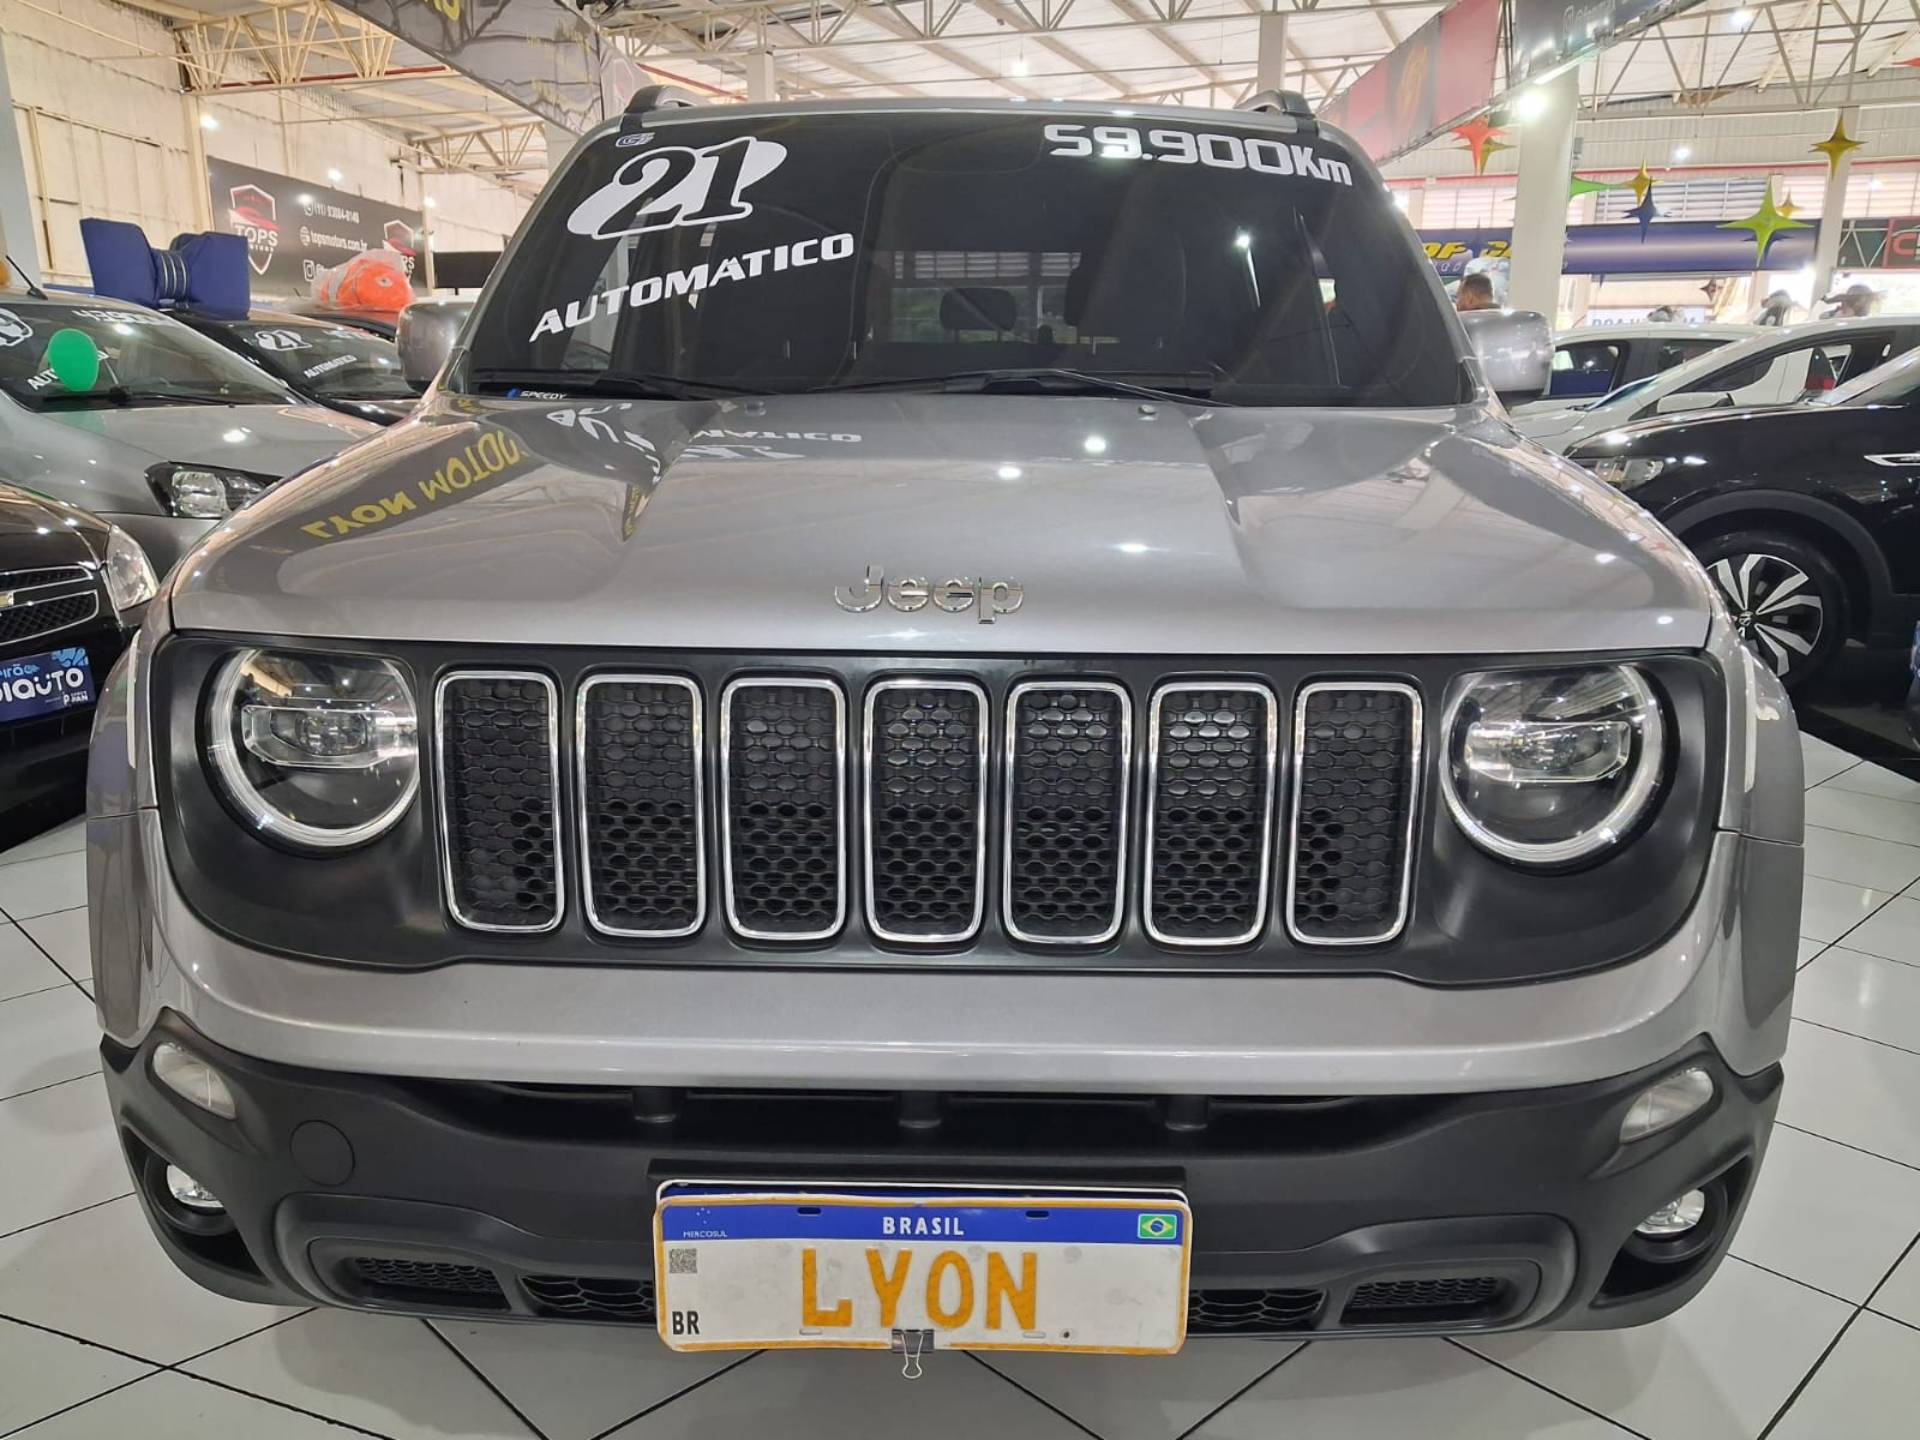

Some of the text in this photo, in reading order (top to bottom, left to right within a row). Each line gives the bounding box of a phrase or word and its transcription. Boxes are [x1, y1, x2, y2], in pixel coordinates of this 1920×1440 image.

[597, 137, 753, 240] 21
[234, 224, 278, 247] TOPS
[255, 330, 312, 351] 21
[835, 565, 1024, 624] Jeep
[882, 1216, 964, 1236] BRASIL
[802, 1247, 1037, 1330] LYON
[672, 1310, 700, 1335] BR
